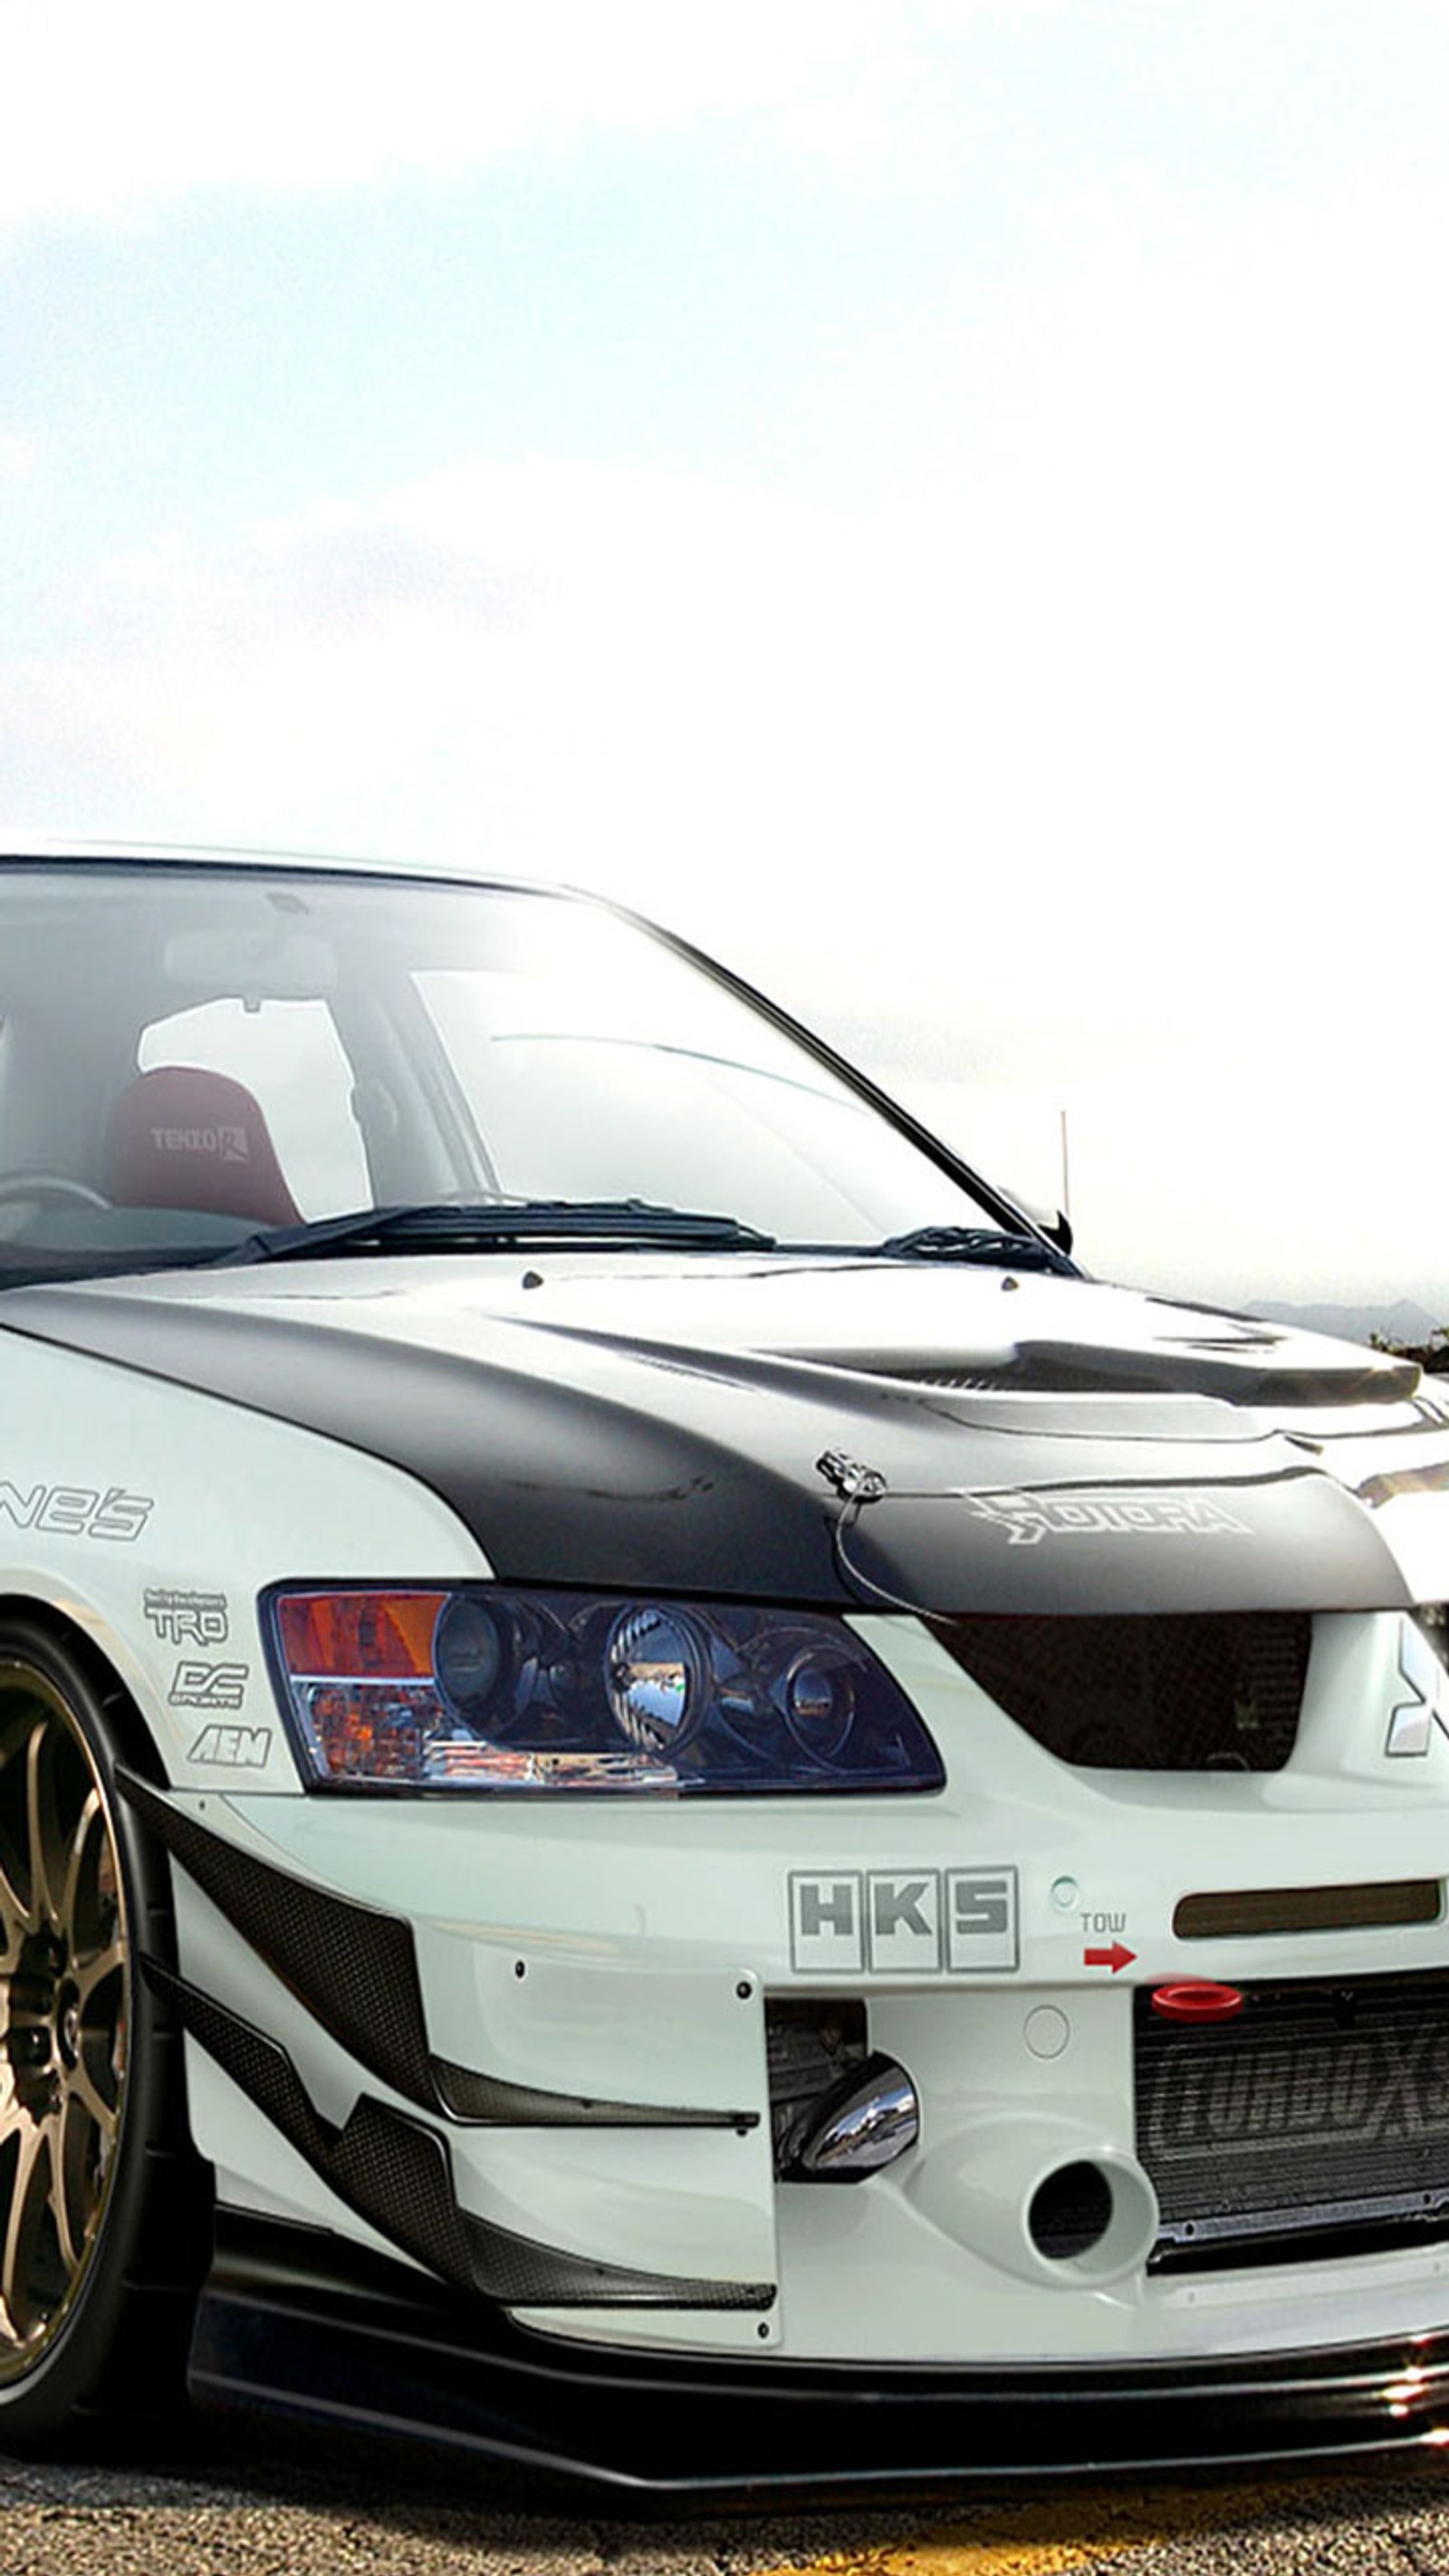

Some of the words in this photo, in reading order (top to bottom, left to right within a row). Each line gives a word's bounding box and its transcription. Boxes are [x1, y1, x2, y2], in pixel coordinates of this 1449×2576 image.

[144, 1608, 227, 1648] TRD
[186, 1723, 272, 1769] AEM
[798, 1879, 1009, 1937] HKS
[1079, 1911, 1127, 1934] TOW
